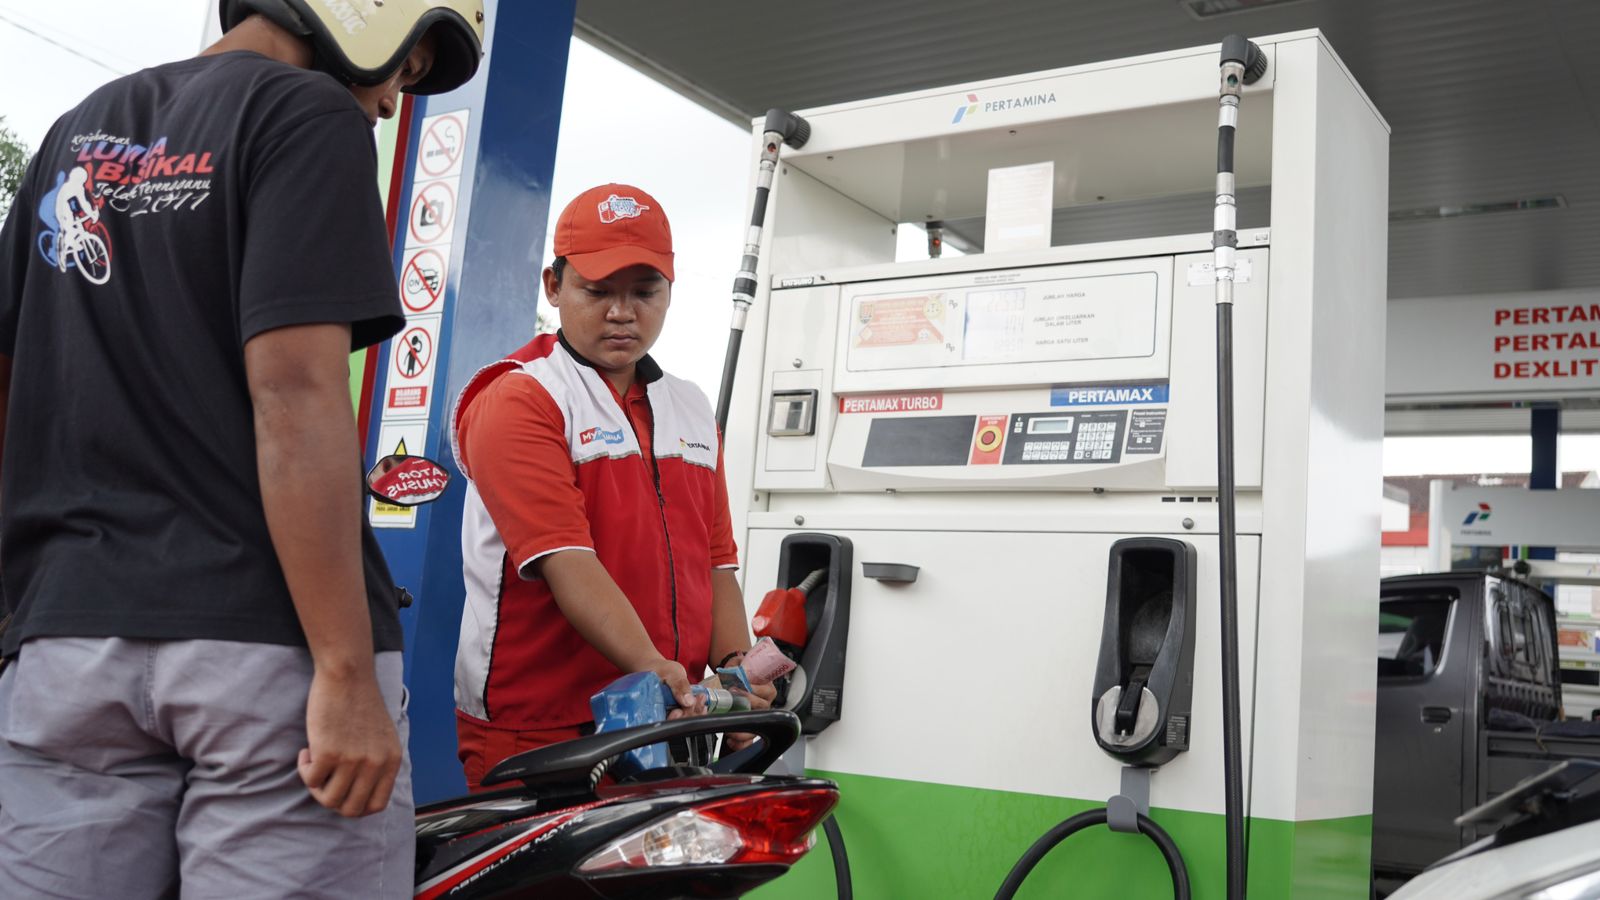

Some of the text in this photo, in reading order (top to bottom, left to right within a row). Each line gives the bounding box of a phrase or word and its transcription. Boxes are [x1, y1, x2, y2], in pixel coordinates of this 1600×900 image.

[984, 93, 1057, 112] PERTAMINA
[843, 396, 938, 412] PERTAMAX TURBO
[1068, 388, 1154, 404] PERTAMAX
